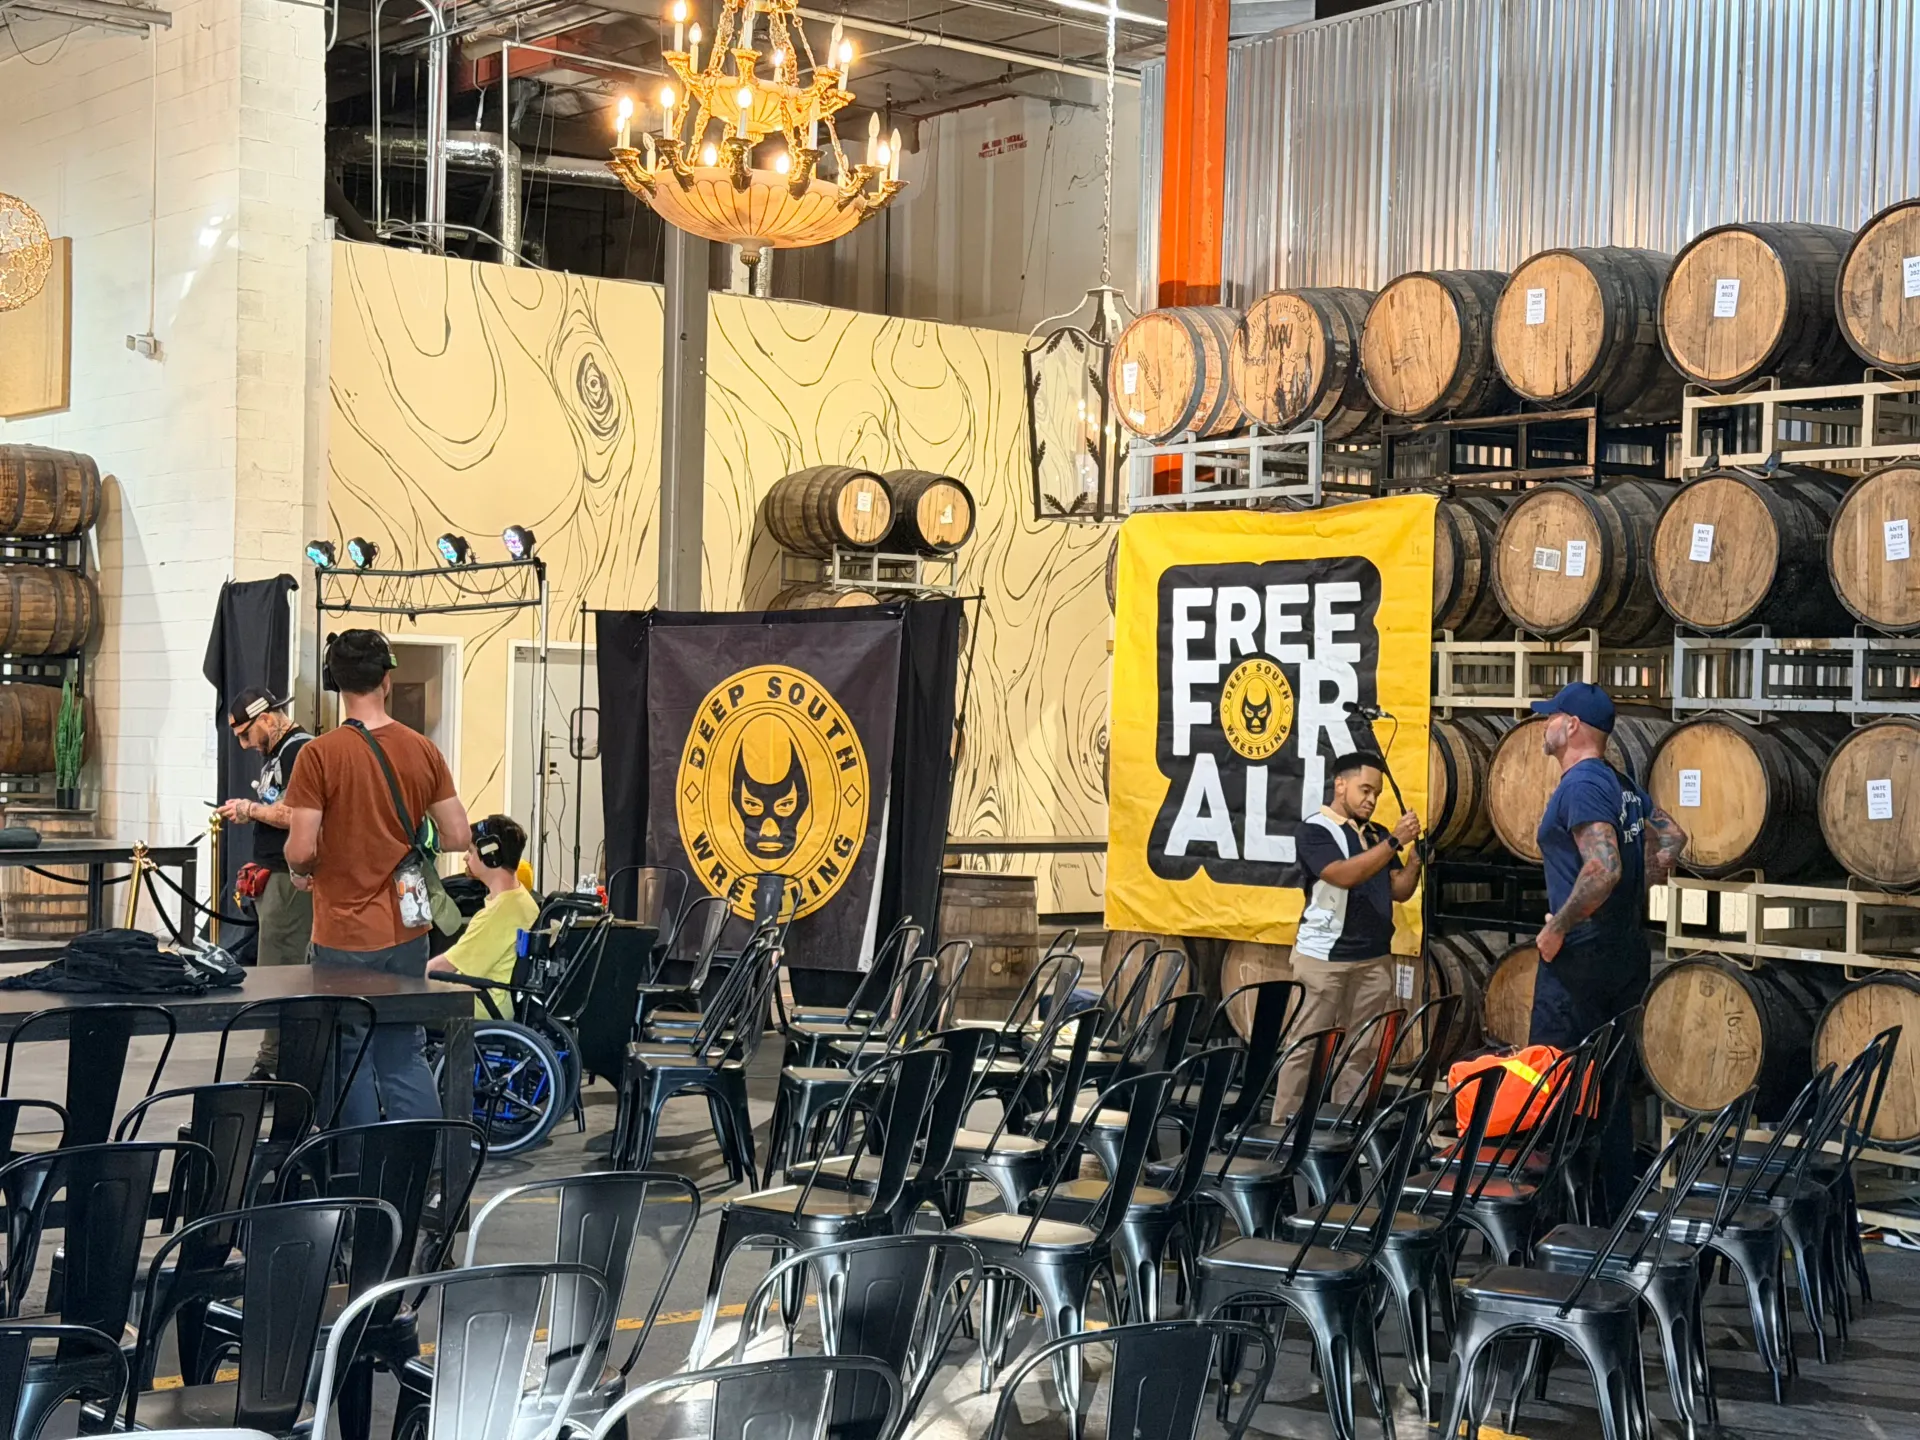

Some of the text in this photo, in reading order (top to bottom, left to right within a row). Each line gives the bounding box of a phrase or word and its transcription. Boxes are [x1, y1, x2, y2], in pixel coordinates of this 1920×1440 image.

[1172, 581, 1361, 664] FREE
[1225, 663, 1290, 700] DEEP SOUTH
[690, 676, 858, 772] DEEP SOUTH
[1227, 724, 1288, 756] WRESTLING
[692, 831, 855, 912] WRELING
